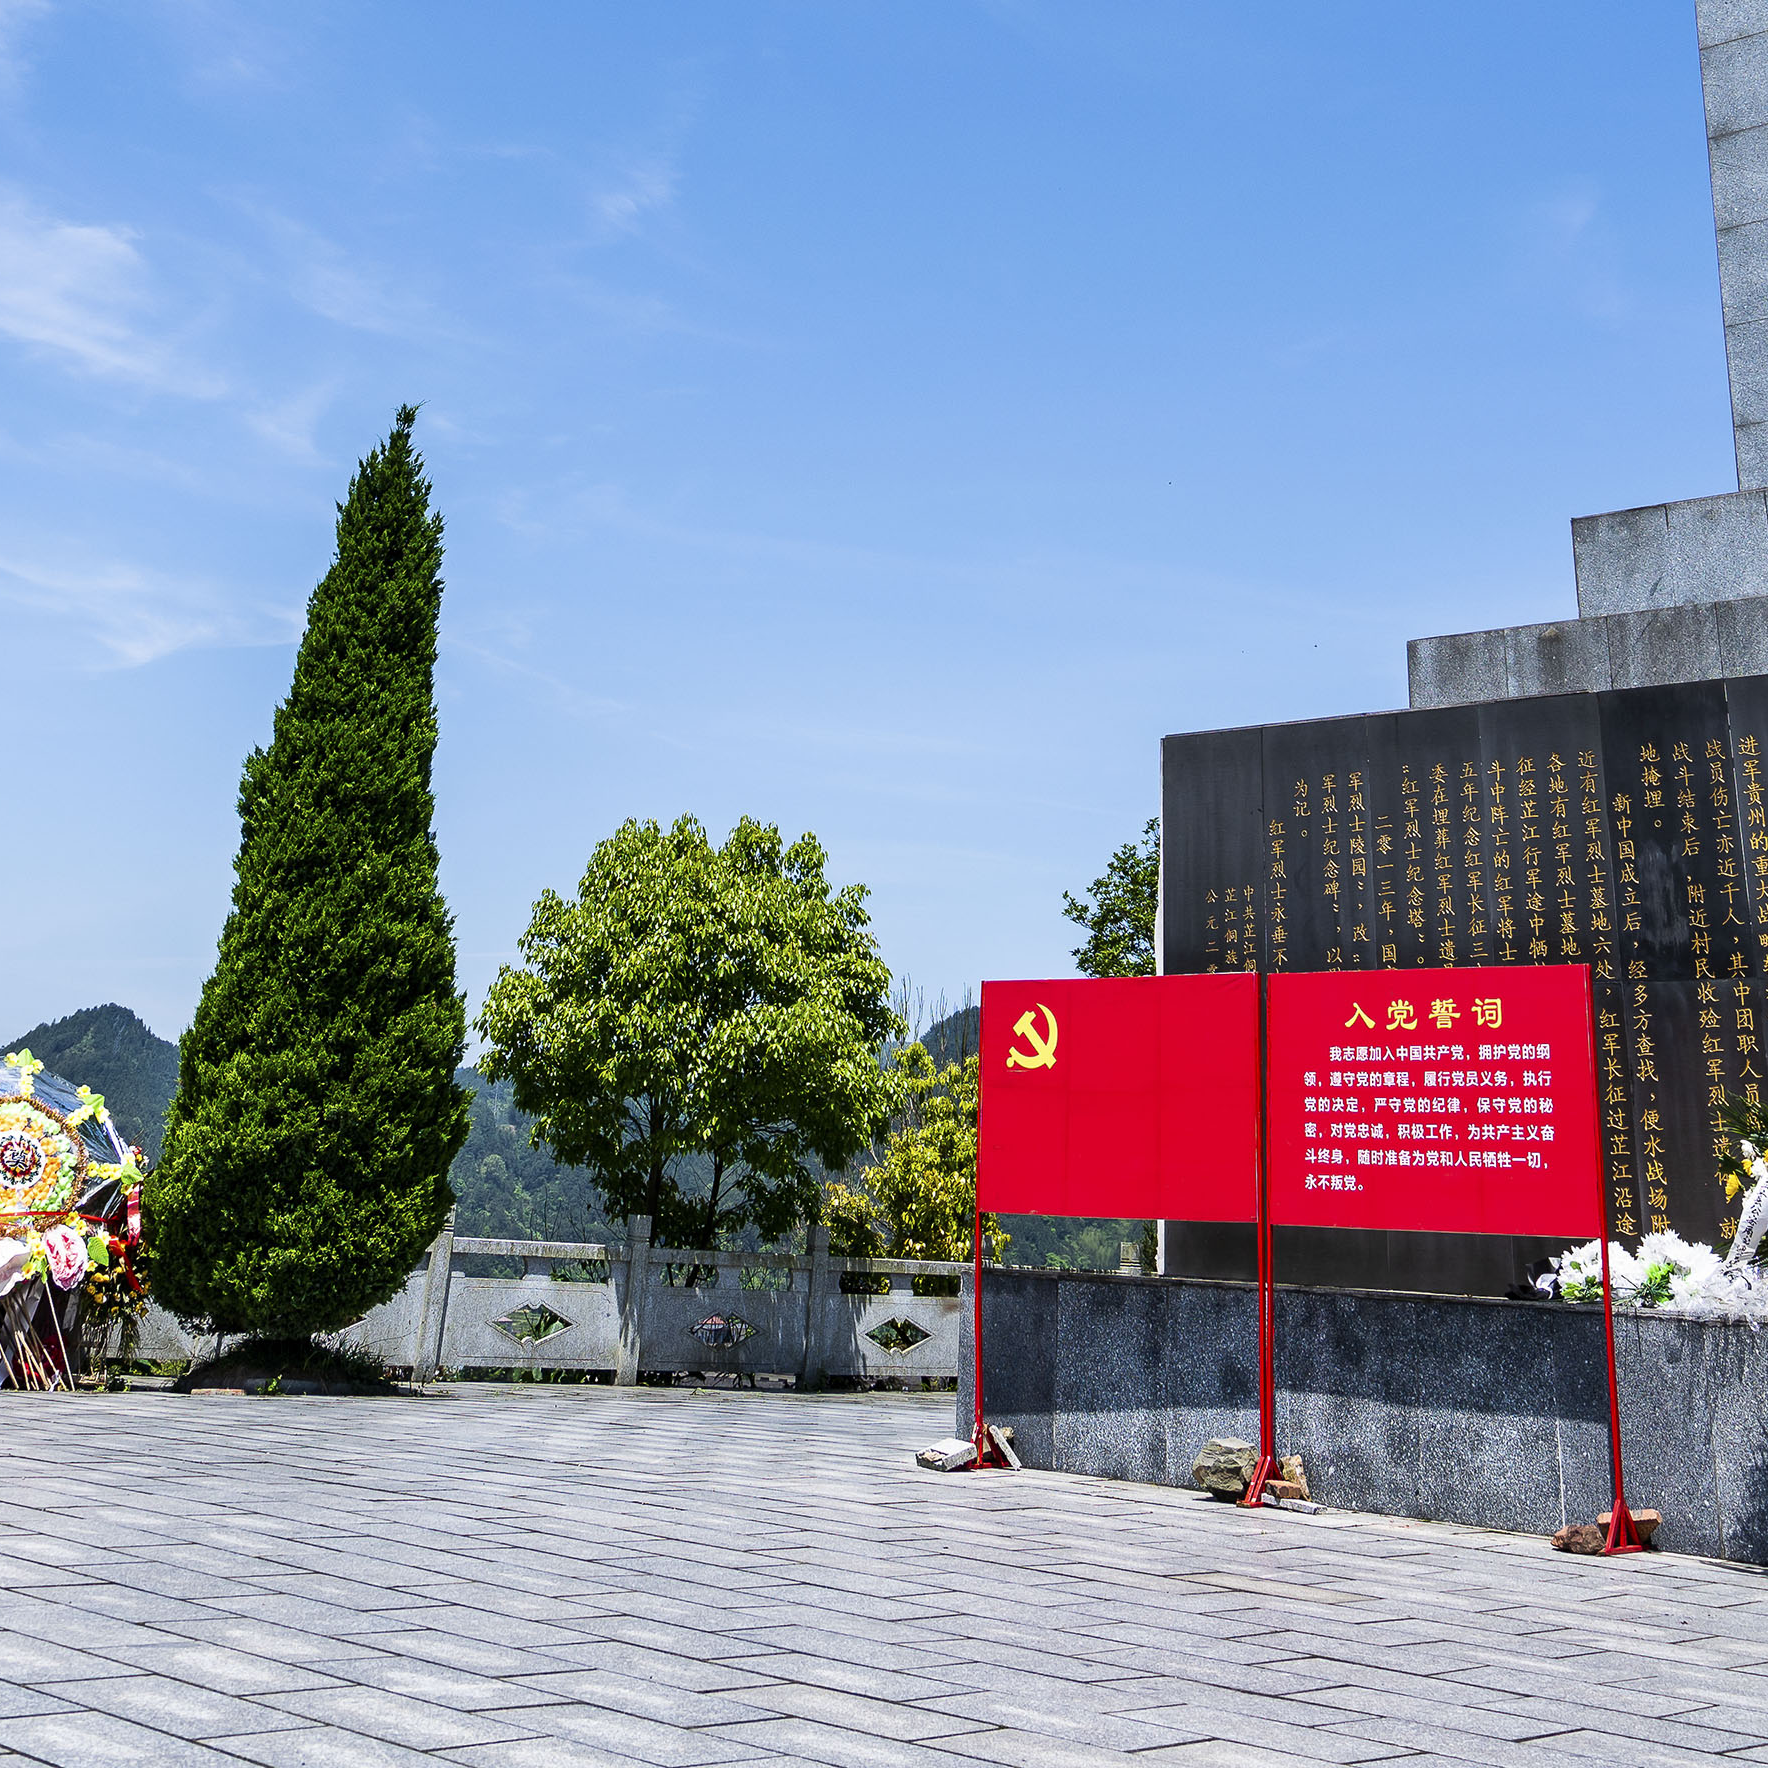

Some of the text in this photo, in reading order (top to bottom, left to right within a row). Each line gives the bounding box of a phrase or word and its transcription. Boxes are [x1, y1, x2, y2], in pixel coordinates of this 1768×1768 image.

[1293, 777, 1311, 837] 为记。
[1637, 742, 1667, 827] 地掩埋。
[1428, 761, 1459, 968] 委在埋葬红军烈士遗
[1458, 761, 1490, 967] 五年纪念红军长征三
[1514, 755, 1550, 965] 征经芷江行军途中牺
[1545, 750, 1582, 964] 各地有红军烈士墓地
[1268, 818, 1289, 973] 红军烈士永垂不
[1374, 815, 1399, 970] 二零一三年，国
[1344, 998, 1503, 1030] 入党誓词
[1304, 1070, 1552, 1088] 领，遵守党的章程，履行党员义务，执行
[1329, 1044, 1551, 1062] 我志愿加入中国共产党，拥护党的纲
[1304, 1097, 1554, 1114] 党的决定，严守党的纪律，保守党的秘
[1304, 1123, 1555, 1142] 密，对党忠诚，积极工作，为共产主义奋
[1304, 1148, 1550, 1169] 斗终身，随时准备为党和人民牺牲一切，
[1304, 1175, 1365, 1192] 永不叛党。
